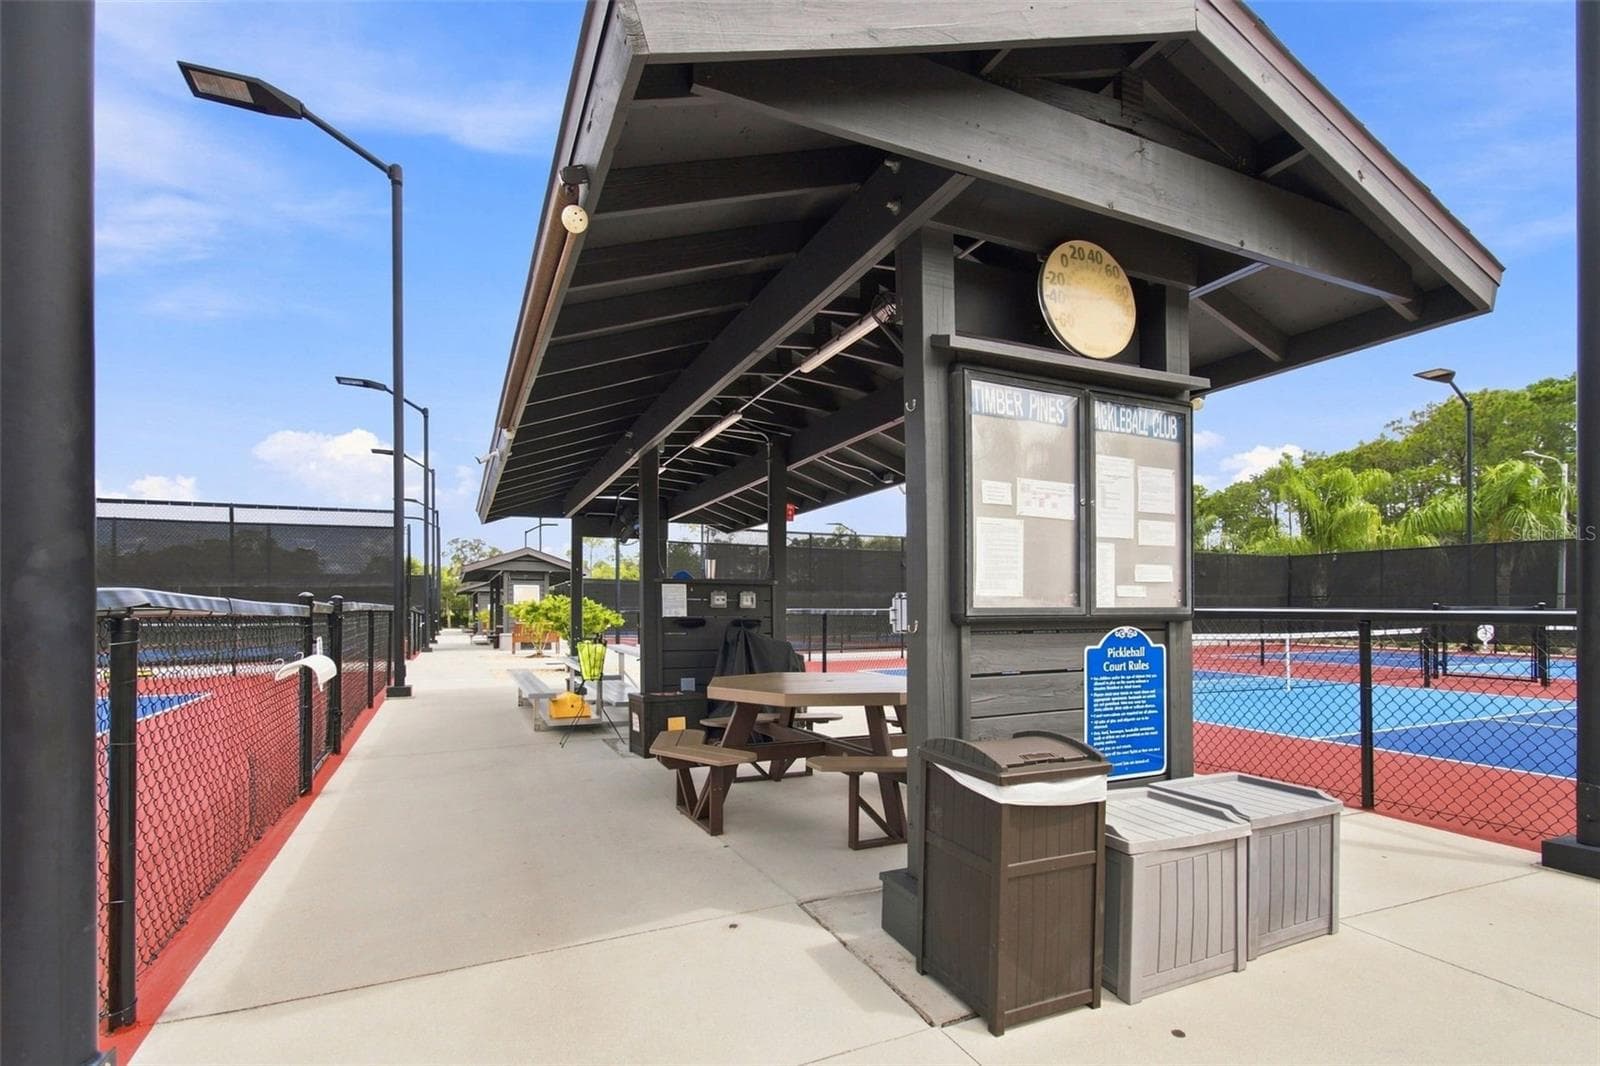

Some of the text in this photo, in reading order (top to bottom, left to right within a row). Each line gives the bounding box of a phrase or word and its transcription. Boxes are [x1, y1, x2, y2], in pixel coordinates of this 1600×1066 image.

[1060, 253, 1069, 268] 0
[1069, 245, 1085, 261] 20
[1087, 249, 1103, 265] 40
[1045, 271, 1065, 286] -20
[1105, 264, 1119, 279] 60
[973, 385, 1065, 425] TIMBER PINES
[1152, 412, 1178, 439] CLUB
[1107, 646, 1146, 658] Pickleball
[1103, 660, 1150, 672] Court Rules
